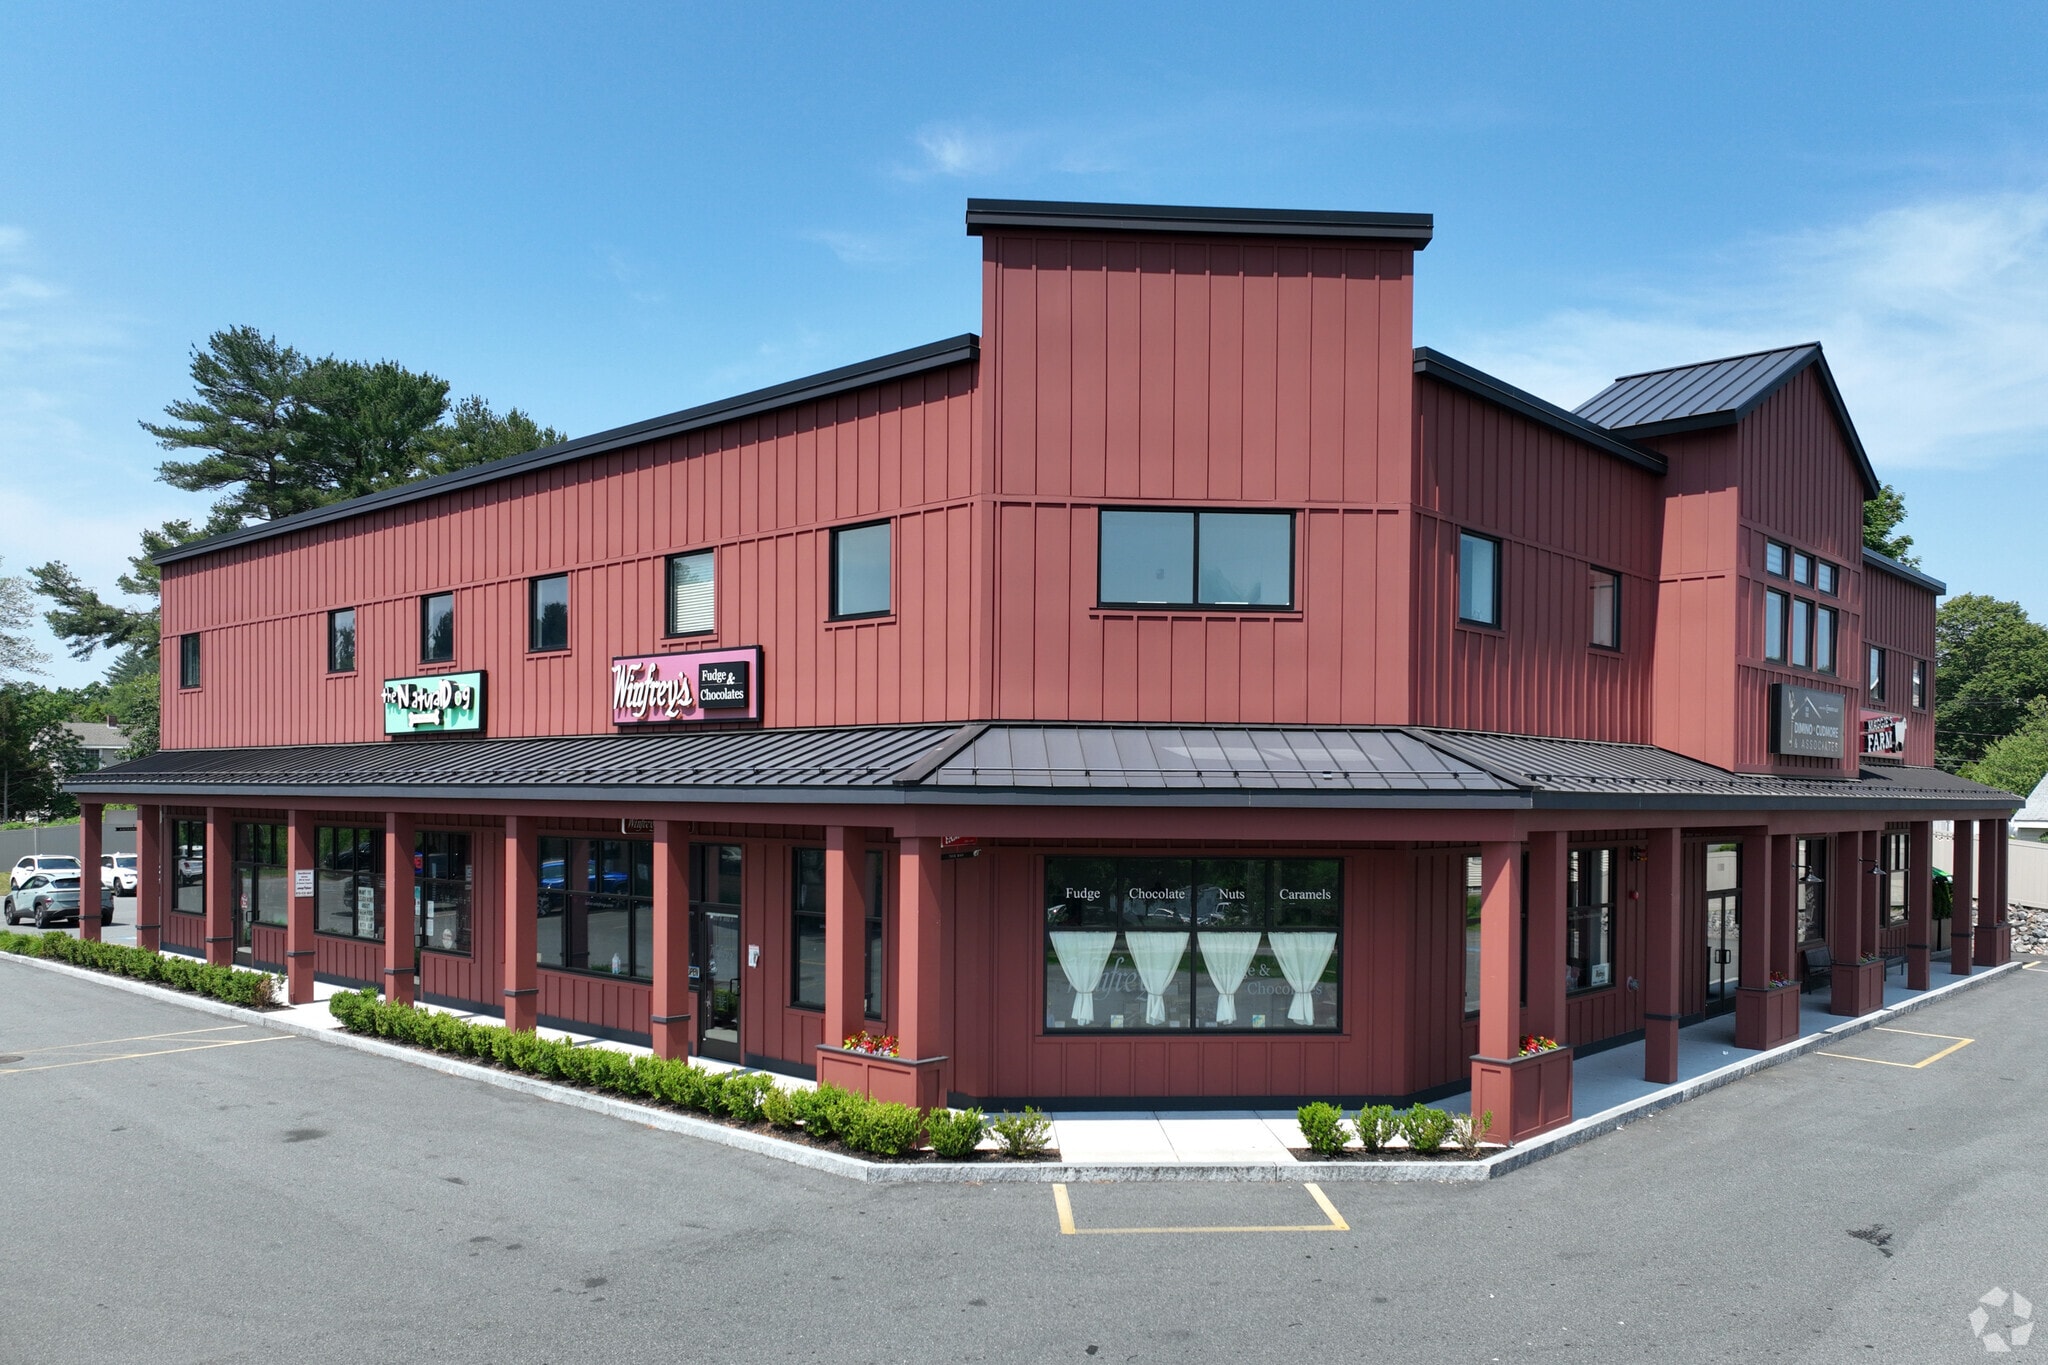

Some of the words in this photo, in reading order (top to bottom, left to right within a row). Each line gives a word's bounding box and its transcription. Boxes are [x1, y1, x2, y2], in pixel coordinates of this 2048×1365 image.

[702, 668, 726, 684] Fudge
[726, 672, 736, 685] &
[381, 687, 397, 703] the
[439, 679, 471, 710] Dog
[611, 662, 693, 718] Winfrey's
[700, 687, 745, 701] Chocolates
[1801, 739, 1838, 752] ASSOCIATES
[1867, 731, 1893, 753] FARM
[1065, 887, 1101, 902] Fudge
[1129, 888, 1186, 899] Chocolate
[1219, 888, 1245, 900] Nuts
[1279, 888, 1331, 900] Caramels
[1259, 963, 1271, 977] &
